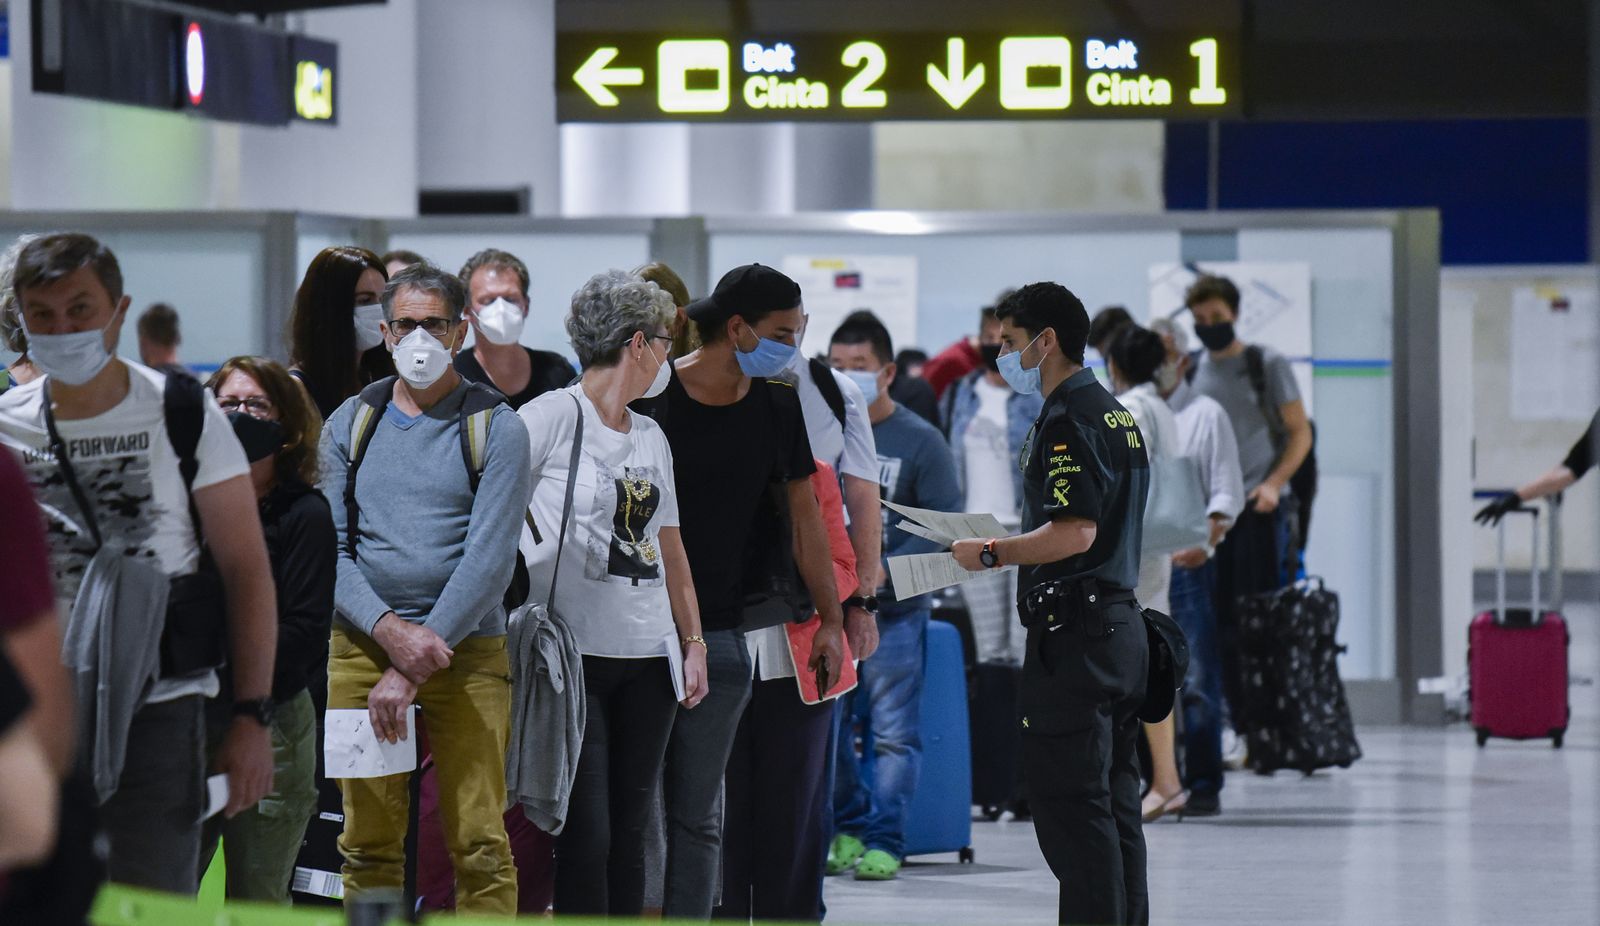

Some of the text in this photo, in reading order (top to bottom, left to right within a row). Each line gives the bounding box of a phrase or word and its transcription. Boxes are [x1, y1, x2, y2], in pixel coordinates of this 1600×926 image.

[743, 41, 887, 108] Cinta 2
[1086, 38, 1226, 105] Cinta 1
[69, 431, 149, 458] FORWARD
[1050, 455, 1072, 464] FISCAL
